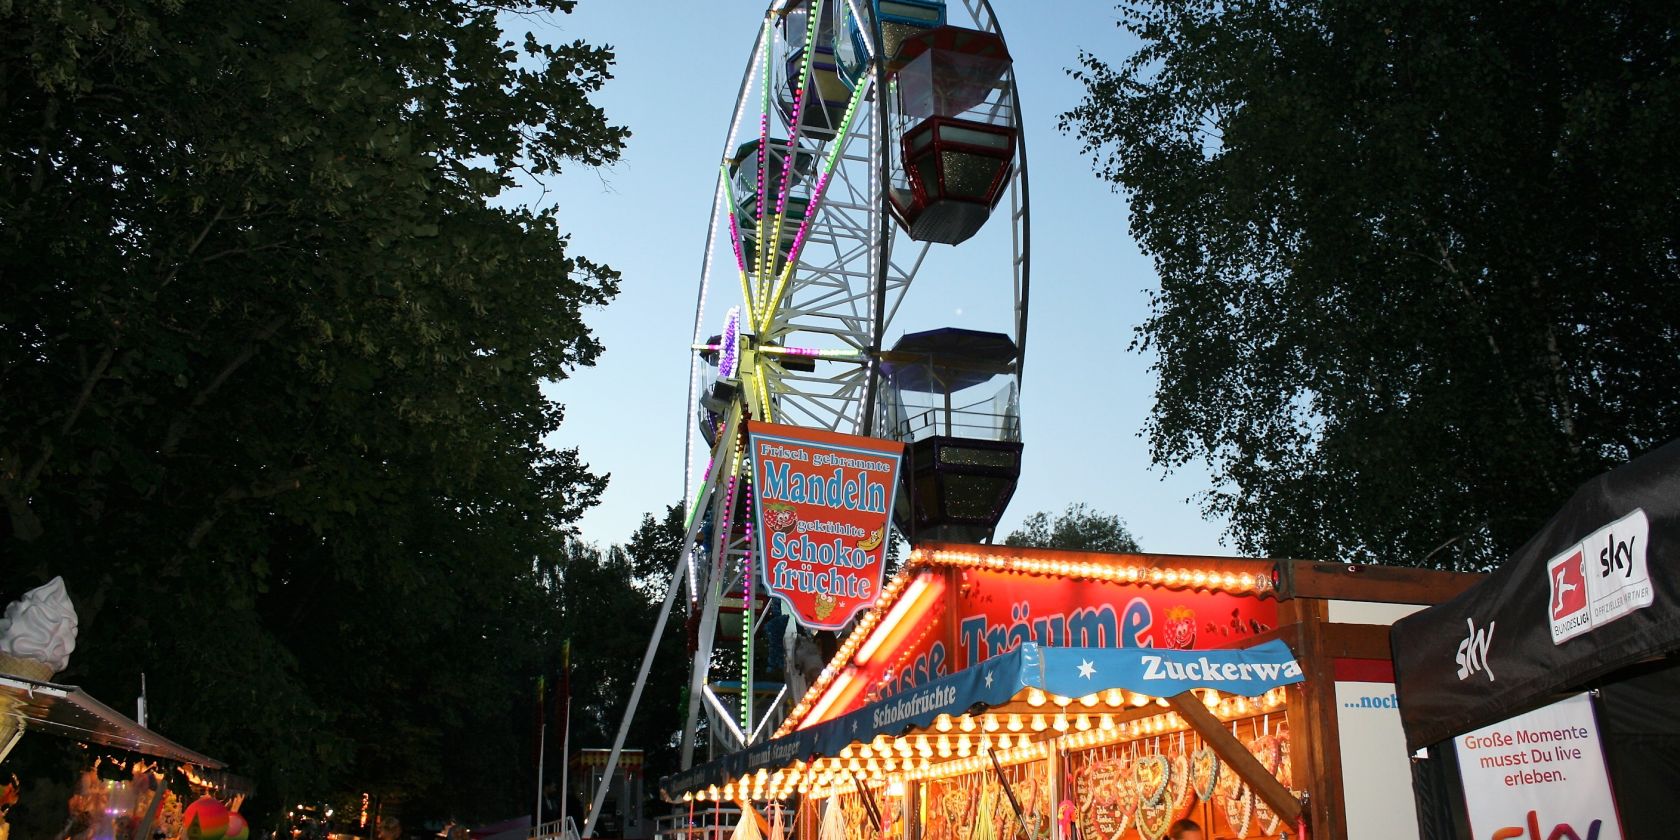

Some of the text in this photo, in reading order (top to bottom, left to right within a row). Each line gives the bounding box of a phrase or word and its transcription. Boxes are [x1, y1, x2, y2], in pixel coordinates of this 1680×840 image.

[760, 443, 890, 473] Frisch gebrannte
[762, 460, 886, 514] Mandeln
[796, 519, 865, 538] gekühlte
[771, 531, 876, 570] Schoko-
[1600, 533, 1635, 578] sky
[773, 562, 872, 599] früchte
[960, 596, 1153, 671] Träume
[1554, 612, 1589, 636] BUNDESLIGA
[1455, 617, 1495, 682] sky
[1141, 655, 1302, 682] Zuckerwa
[873, 685, 956, 729] Schokofrüchte
[1465, 726, 1588, 750] Große Momente
[1480, 746, 1582, 768] musst Du live
[1504, 769, 1567, 787] erleben.
